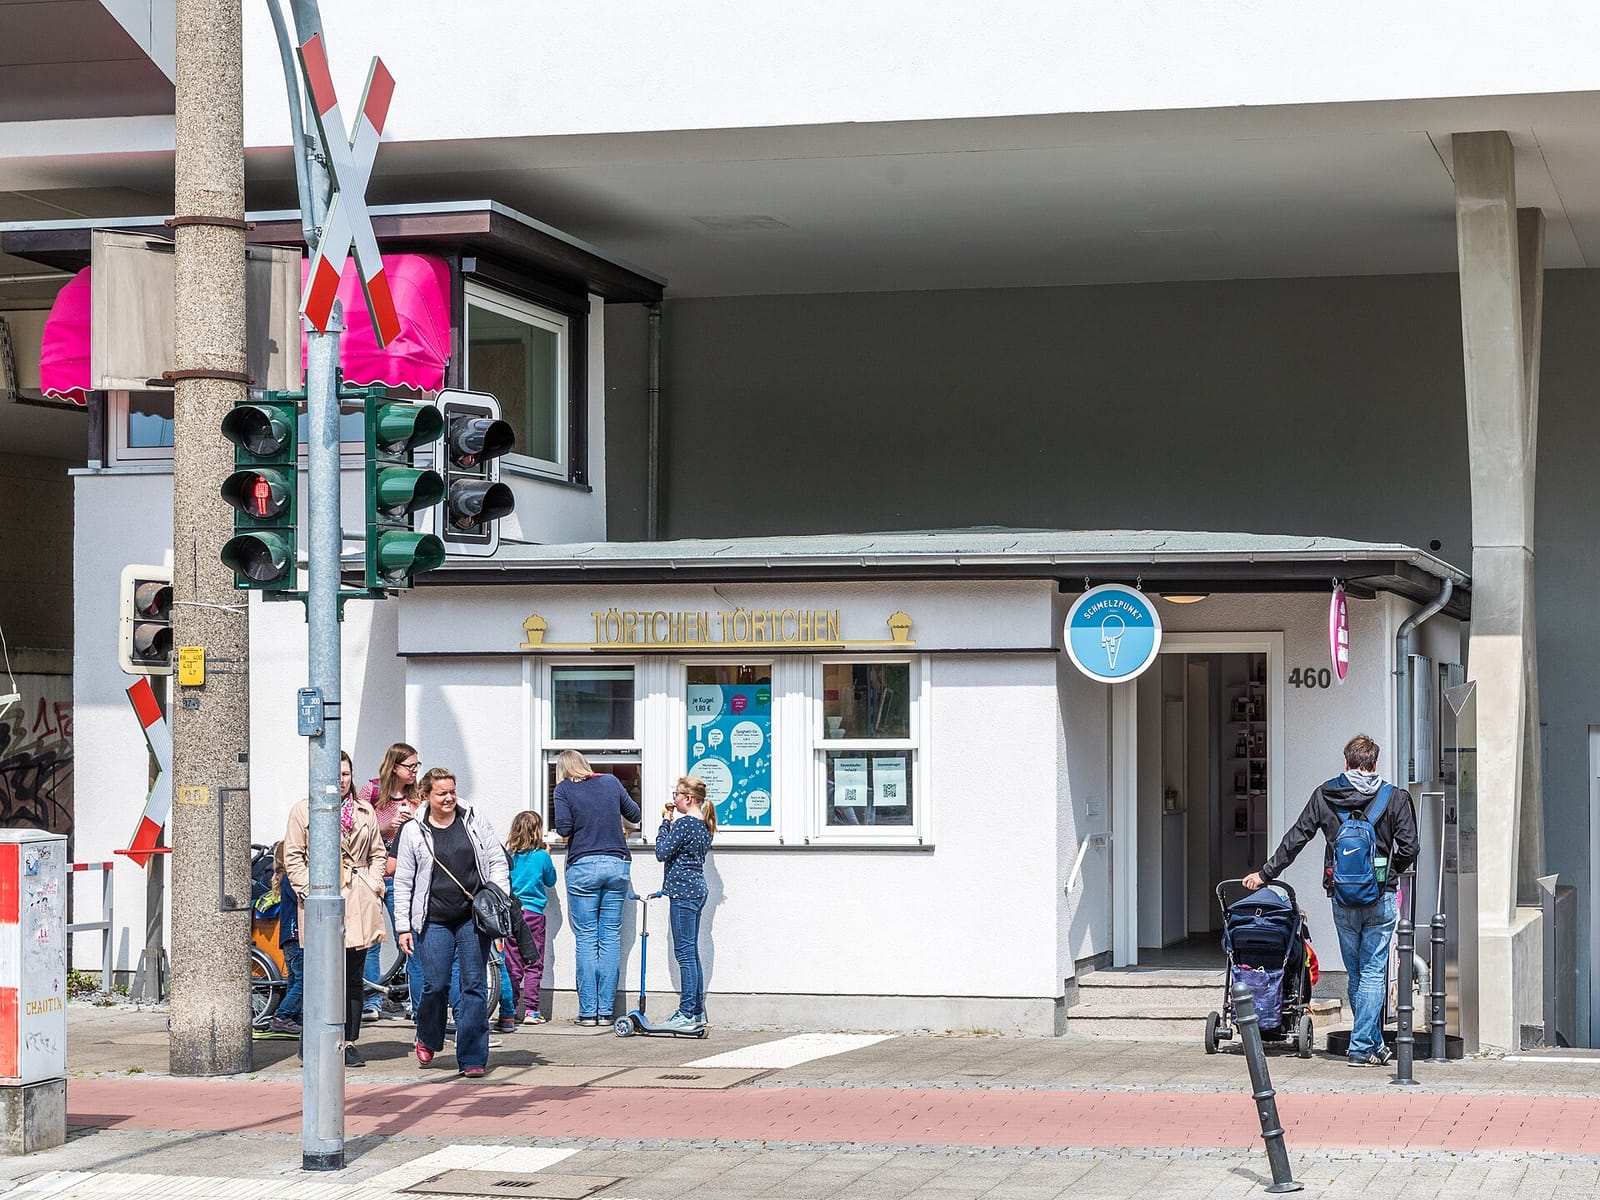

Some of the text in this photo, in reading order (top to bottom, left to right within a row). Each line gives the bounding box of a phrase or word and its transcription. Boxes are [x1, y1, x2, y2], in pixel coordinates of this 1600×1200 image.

[1083, 599, 1143, 621] SCHMELZPUNKT
[591, 606, 840, 644] TÖRTCHEN TÖRTCHEN
[1288, 667, 1331, 689] 460
[699, 696, 714, 704] Kugel
[26, 996, 63, 1016] CHAOTIX
